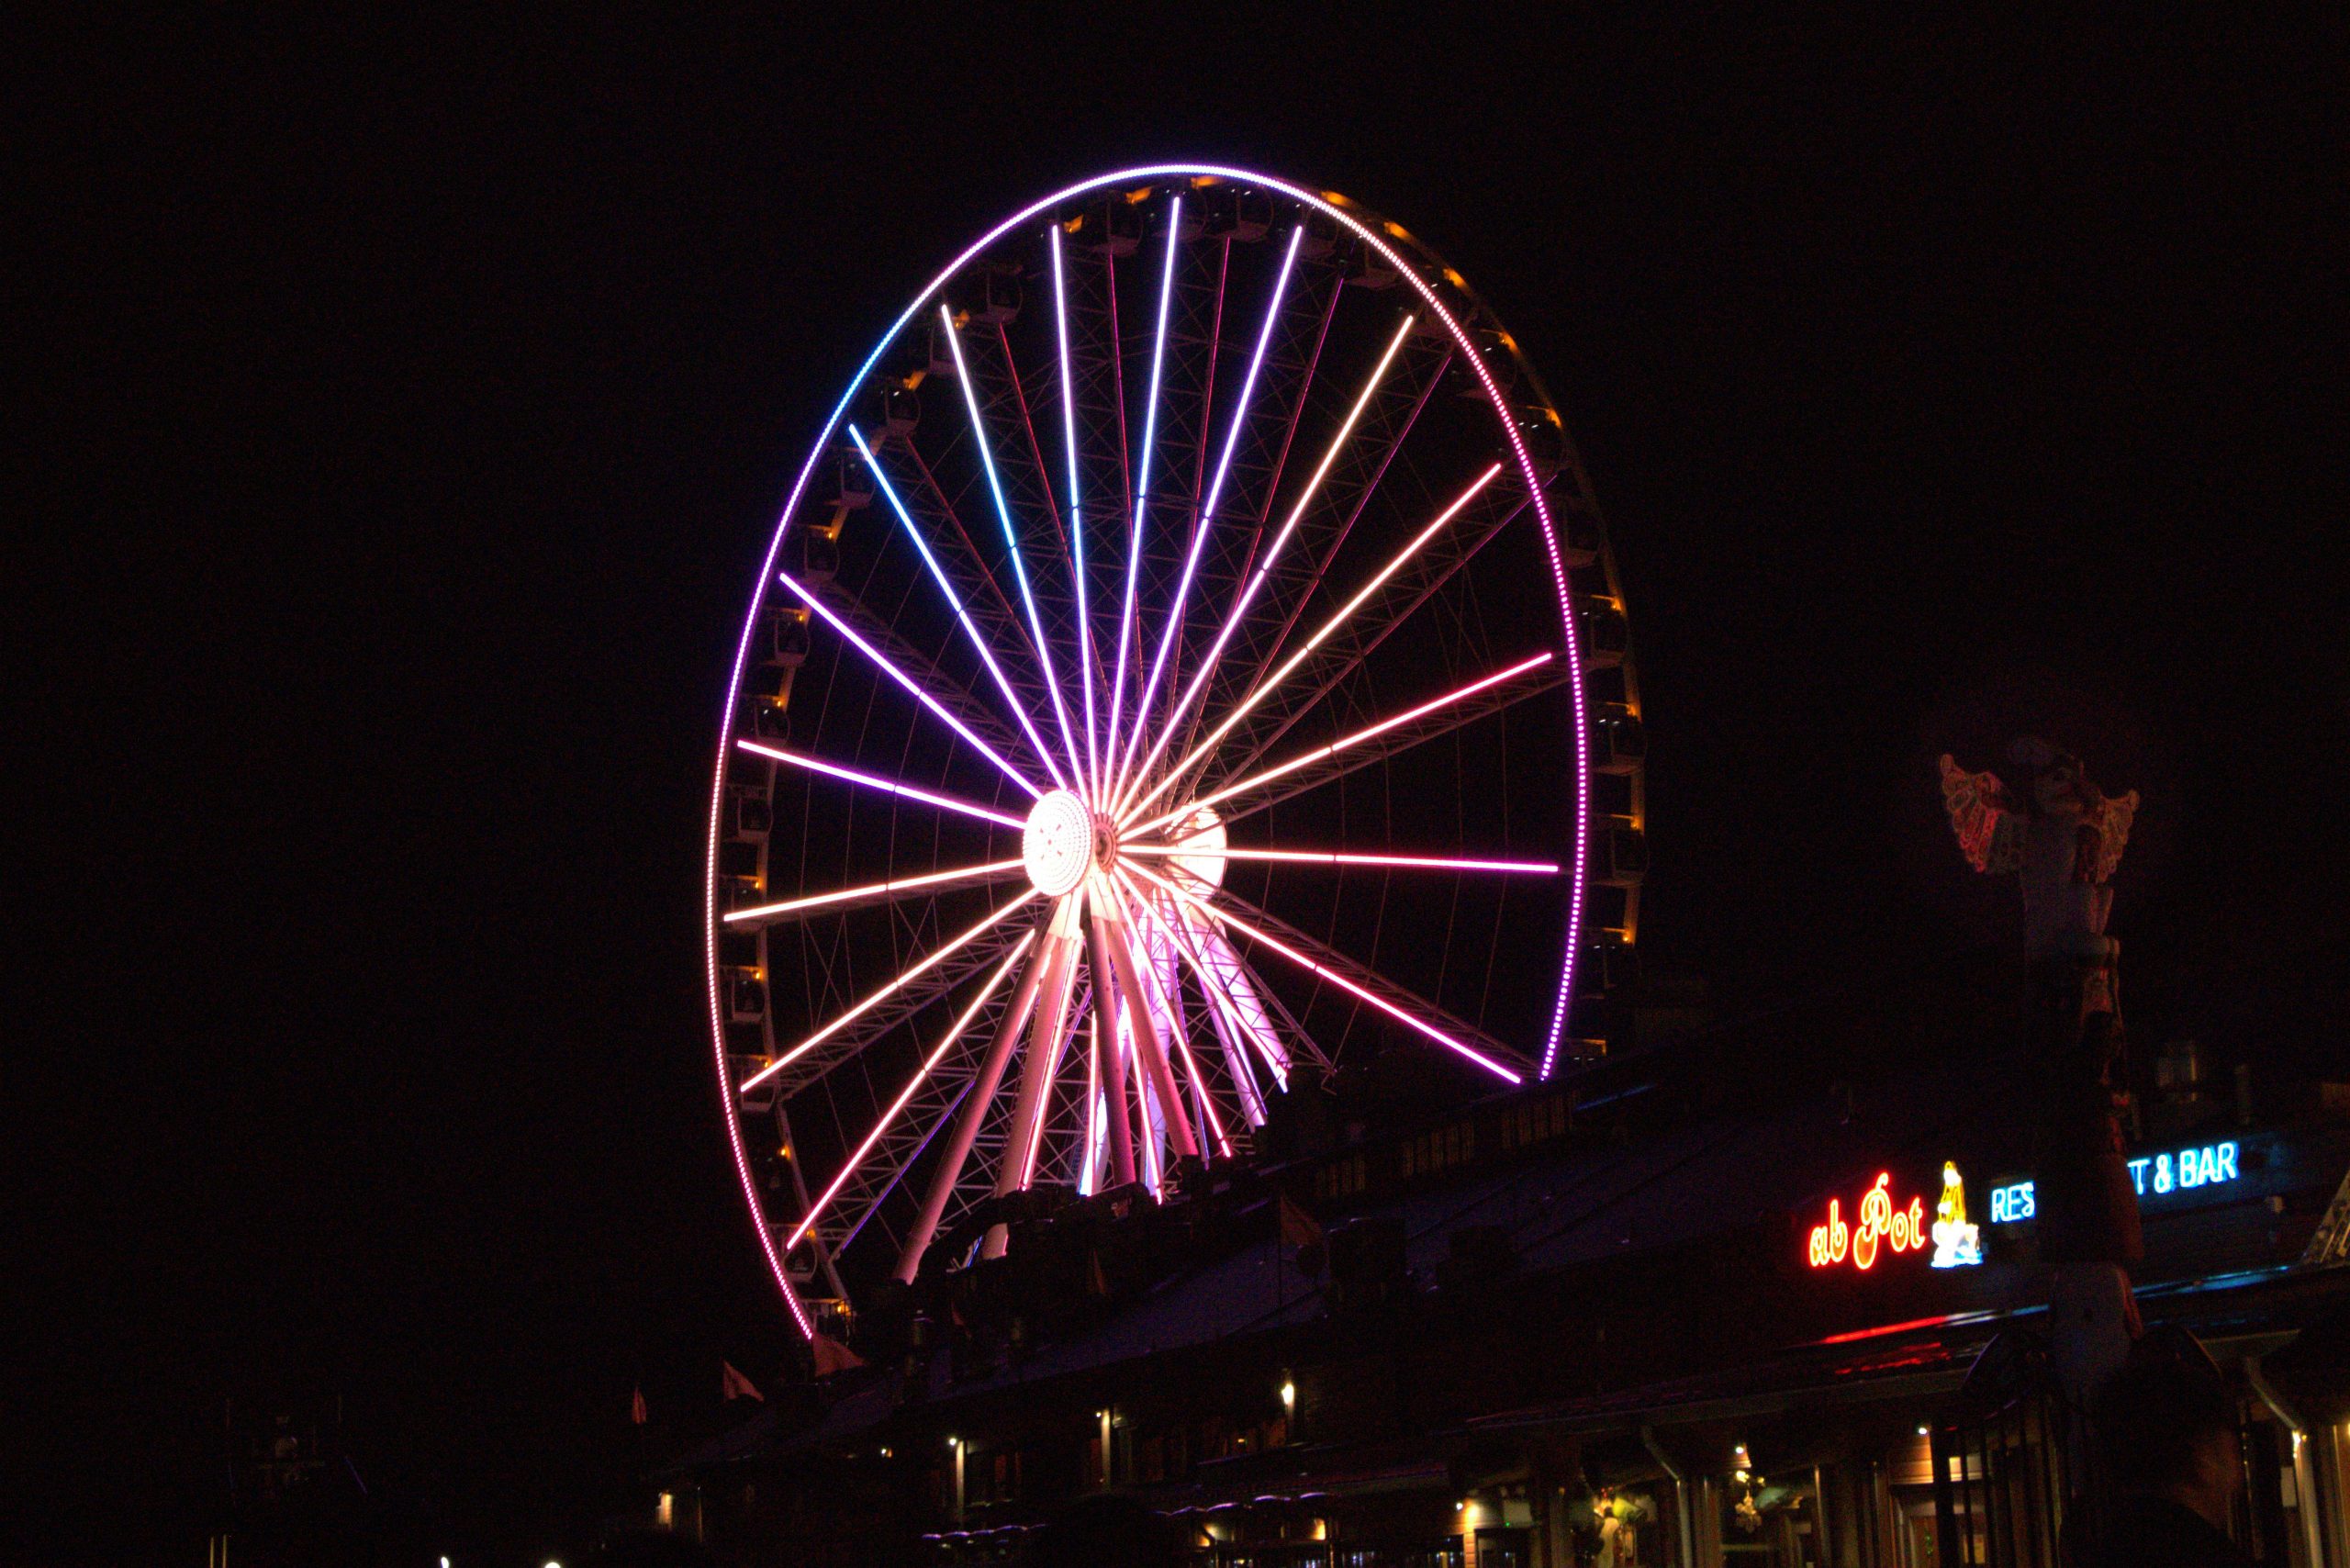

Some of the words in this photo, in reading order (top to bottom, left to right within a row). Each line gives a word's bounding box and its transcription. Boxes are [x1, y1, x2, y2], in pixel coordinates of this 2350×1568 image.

[2154, 1152, 2173, 1194] &
[2178, 1141, 2240, 1188] BAR
[1852, 1171, 1927, 1271] Pot
